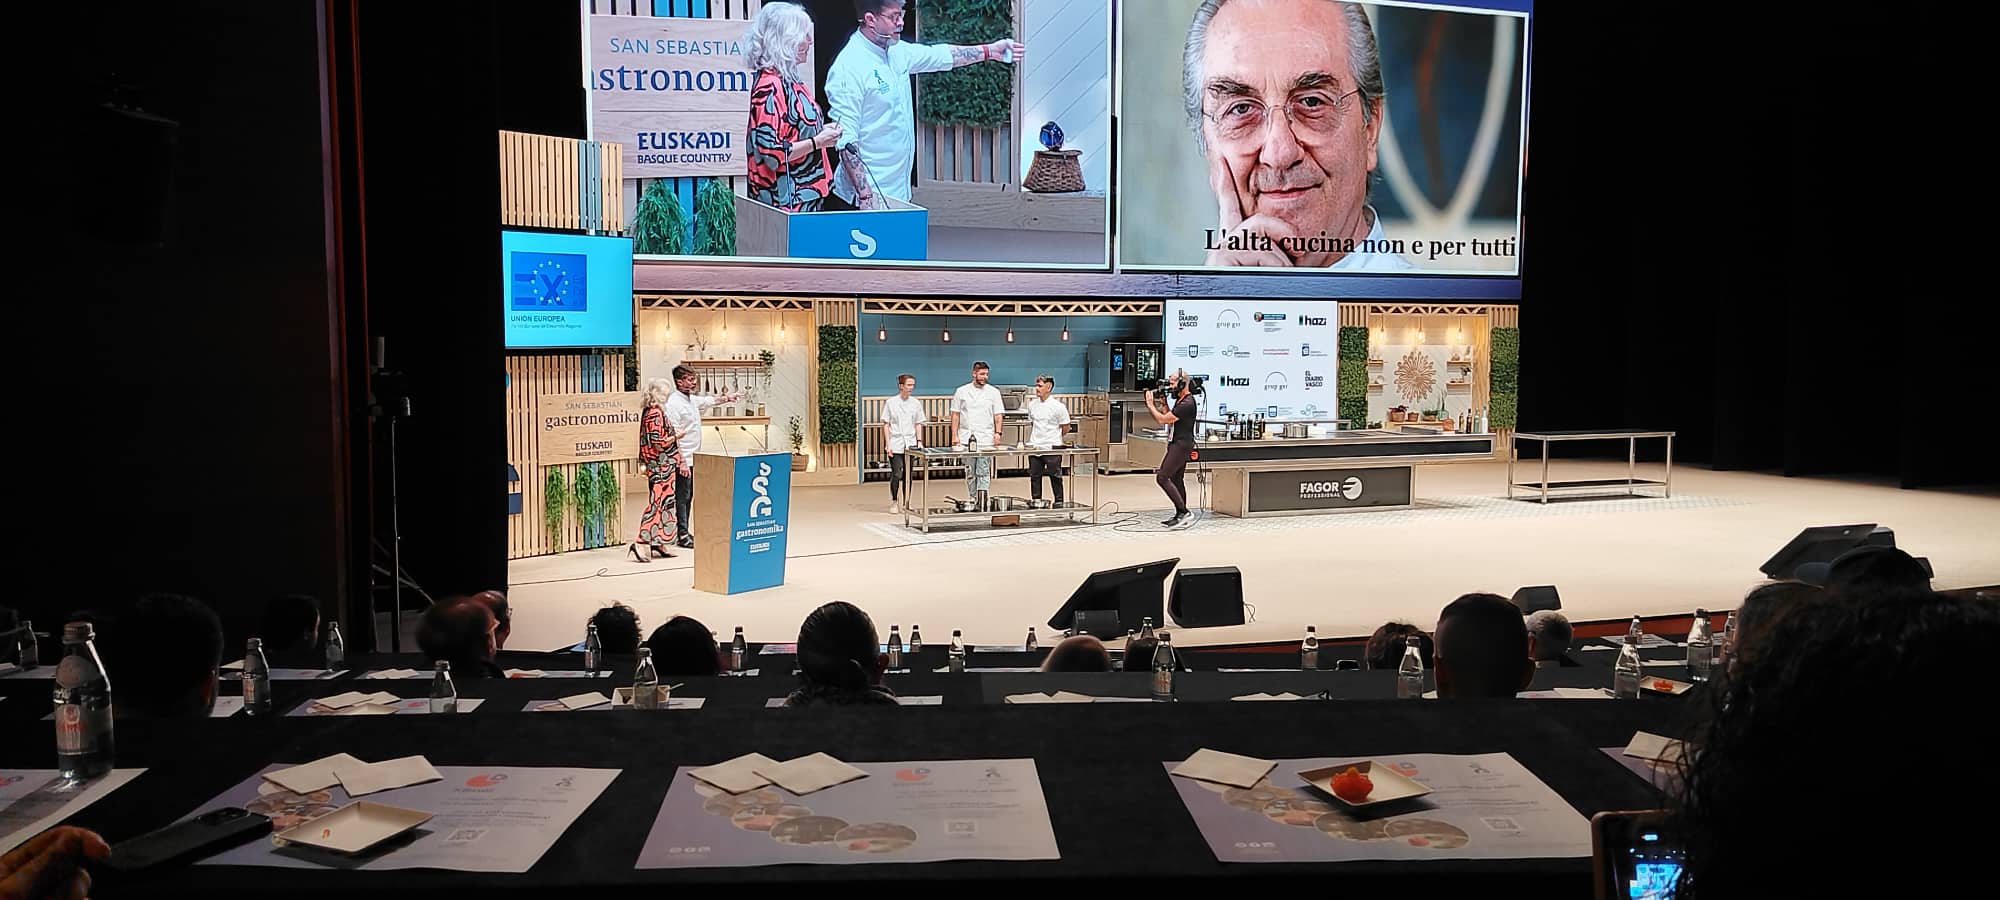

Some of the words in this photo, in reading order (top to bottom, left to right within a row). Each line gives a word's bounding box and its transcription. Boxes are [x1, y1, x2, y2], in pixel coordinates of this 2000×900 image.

[610, 38, 649, 54] SAN
[656, 39, 742, 56] SEBASTIA
[637, 132, 731, 150] EUSKADI
[637, 154, 679, 165] BASQUE
[680, 153, 732, 164] COUNTRY
[1204, 229, 1272, 251] L'alta
[1279, 231, 1355, 253] cucina
[1361, 238, 1405, 254] non
[1411, 240, 1424, 255] e
[1430, 239, 1466, 261] per
[1471, 236, 1516, 257] tutti
[533, 315, 566, 323] EUROPEA
[1304, 314, 1327, 326] hazi
[1226, 375, 1250, 387] hazi
[565, 402, 581, 410] SAN
[544, 409, 640, 431] gastronomika
[575, 441, 613, 451] EUSKADI
[1300, 481, 1339, 493] FAGOR
[735, 524, 784, 541] gastronomika
